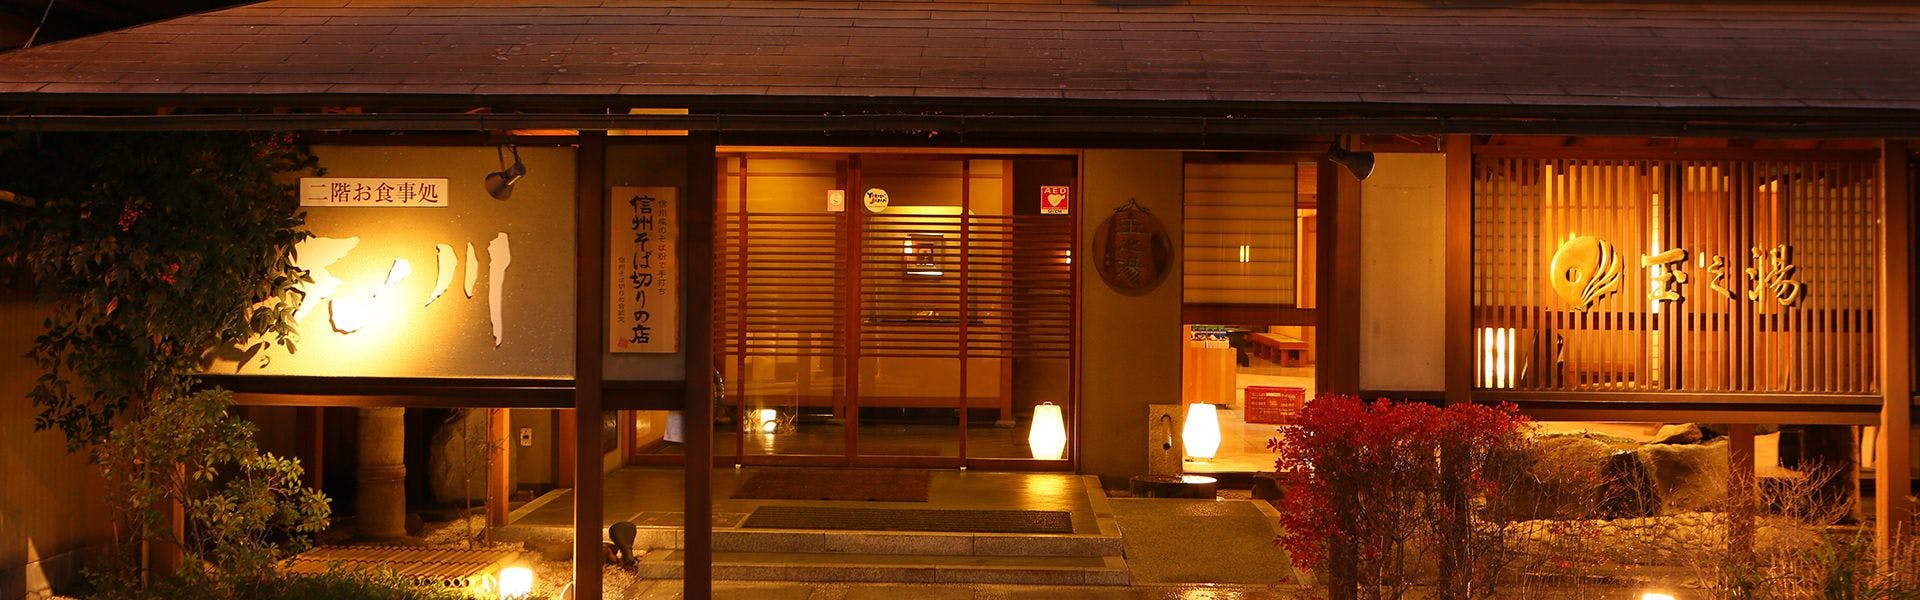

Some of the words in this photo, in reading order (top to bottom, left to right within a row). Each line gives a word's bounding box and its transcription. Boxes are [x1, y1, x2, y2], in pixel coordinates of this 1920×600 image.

[308, 182, 438, 203] 二階お食事処
[630, 195, 655, 344] 信州そば切りの店
[1641, 244, 1801, 306] 玉之湯
